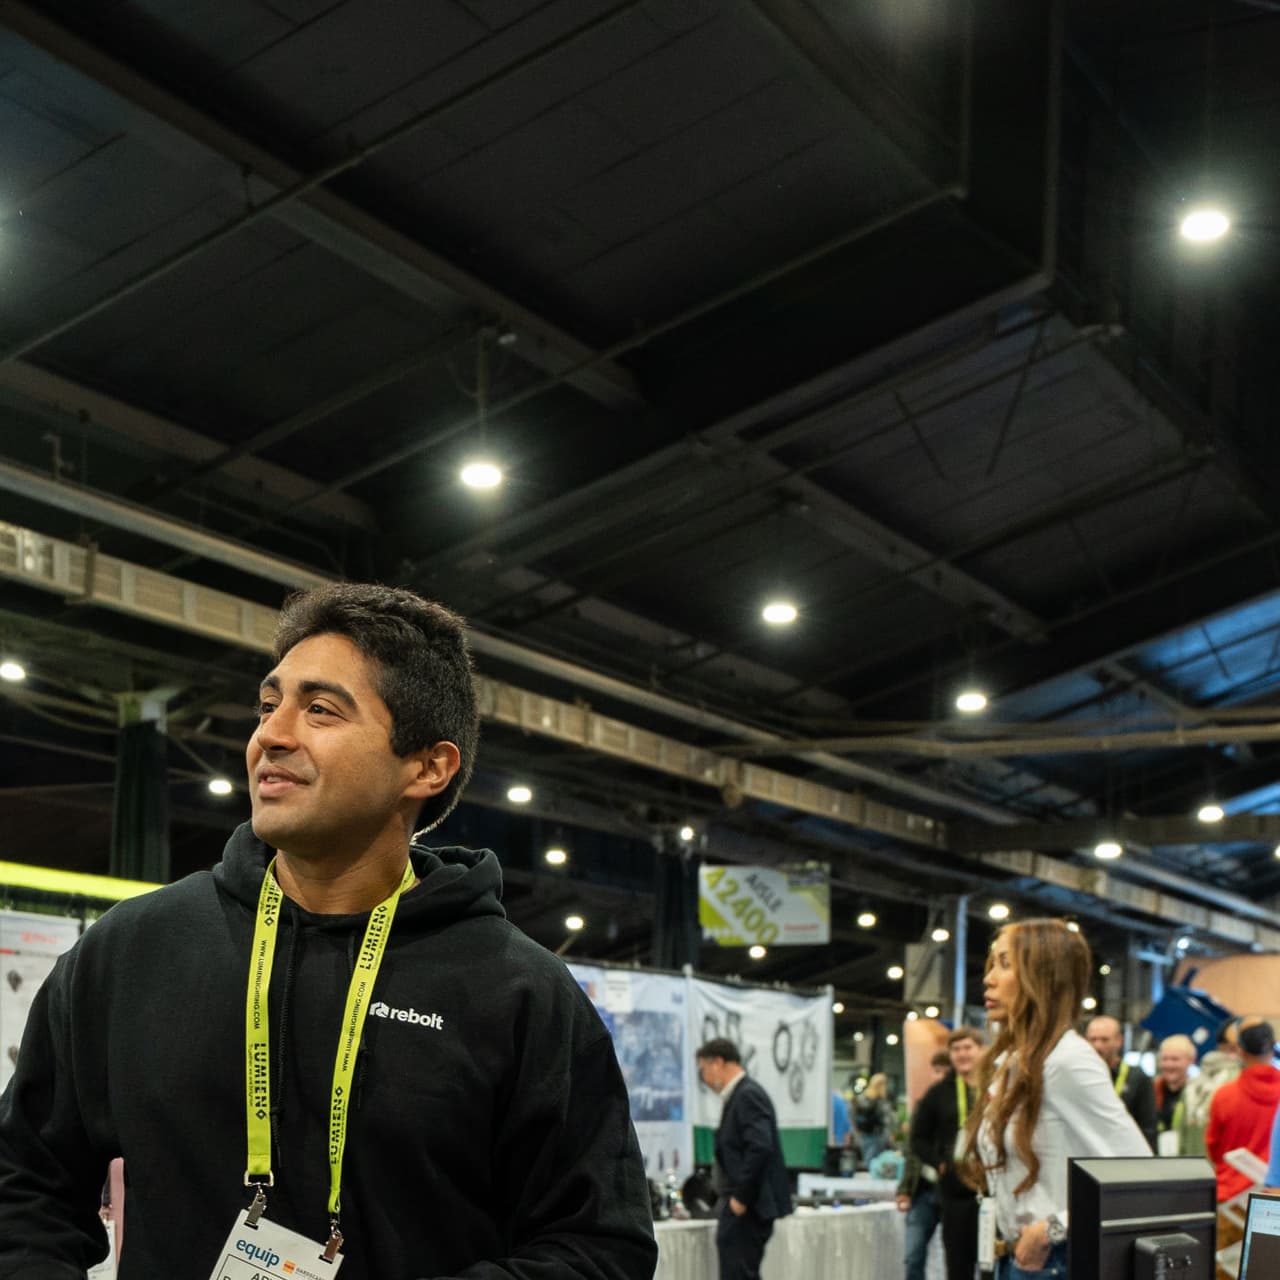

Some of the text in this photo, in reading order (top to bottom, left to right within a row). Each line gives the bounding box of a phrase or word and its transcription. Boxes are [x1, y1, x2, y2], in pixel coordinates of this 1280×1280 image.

[703, 866, 779, 946] 42400
[360, 911, 387, 970] LUMIEN
[253, 940, 268, 1030] WWW.LUMIENLIGHTING.COM
[341, 981, 367, 1072] WWW.LUMIENLIGHTING.COM
[390, 1007, 444, 1031] rebolt
[253, 1042, 267, 1109] LUMIEN
[330, 1097, 343, 1165] LUMIEN
[235, 1239, 280, 1268] equip
